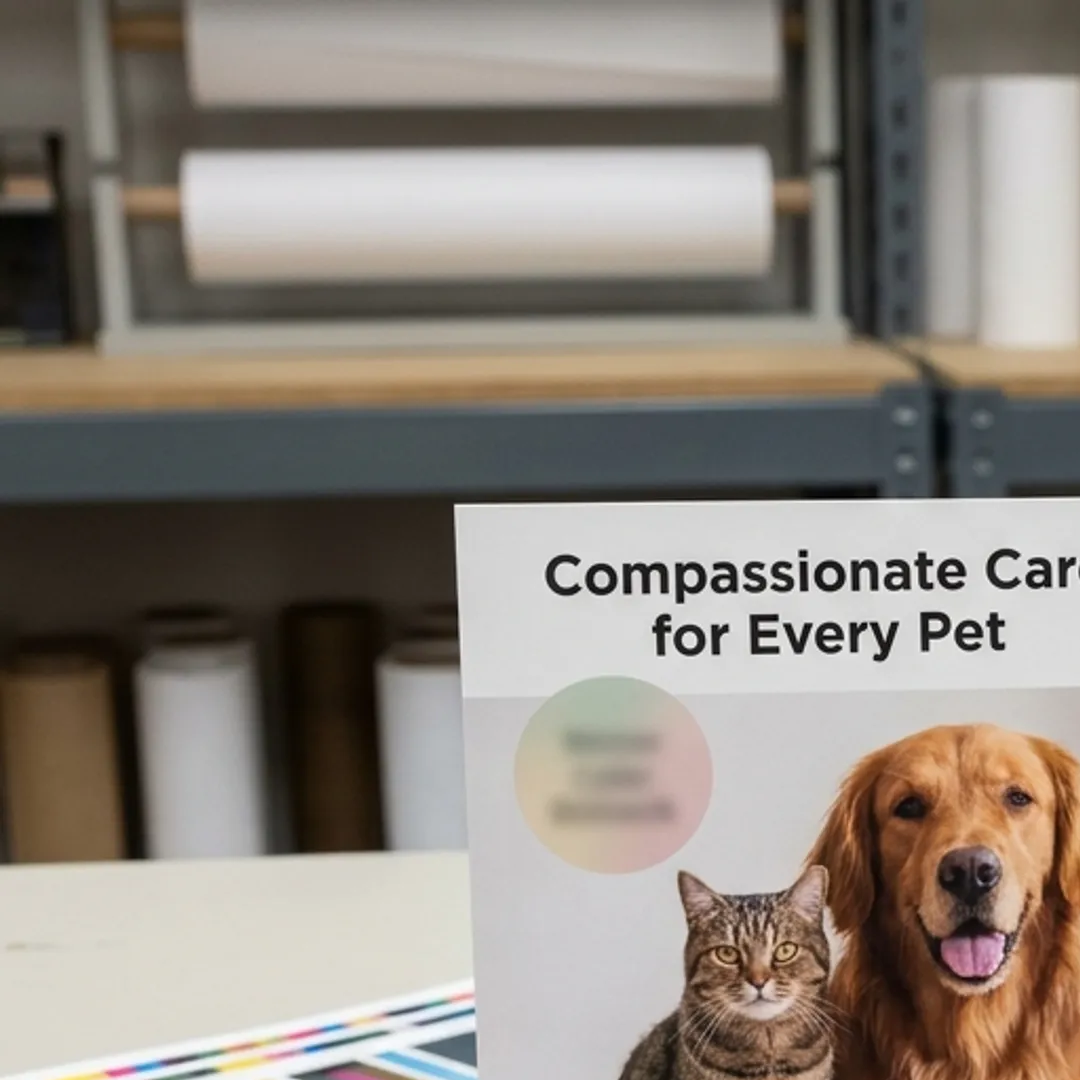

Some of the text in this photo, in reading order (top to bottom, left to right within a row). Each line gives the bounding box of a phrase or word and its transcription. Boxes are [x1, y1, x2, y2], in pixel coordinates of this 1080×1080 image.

[544, 548, 968, 605] Compassionate
[651, 611, 1006, 663] for Every Pet
